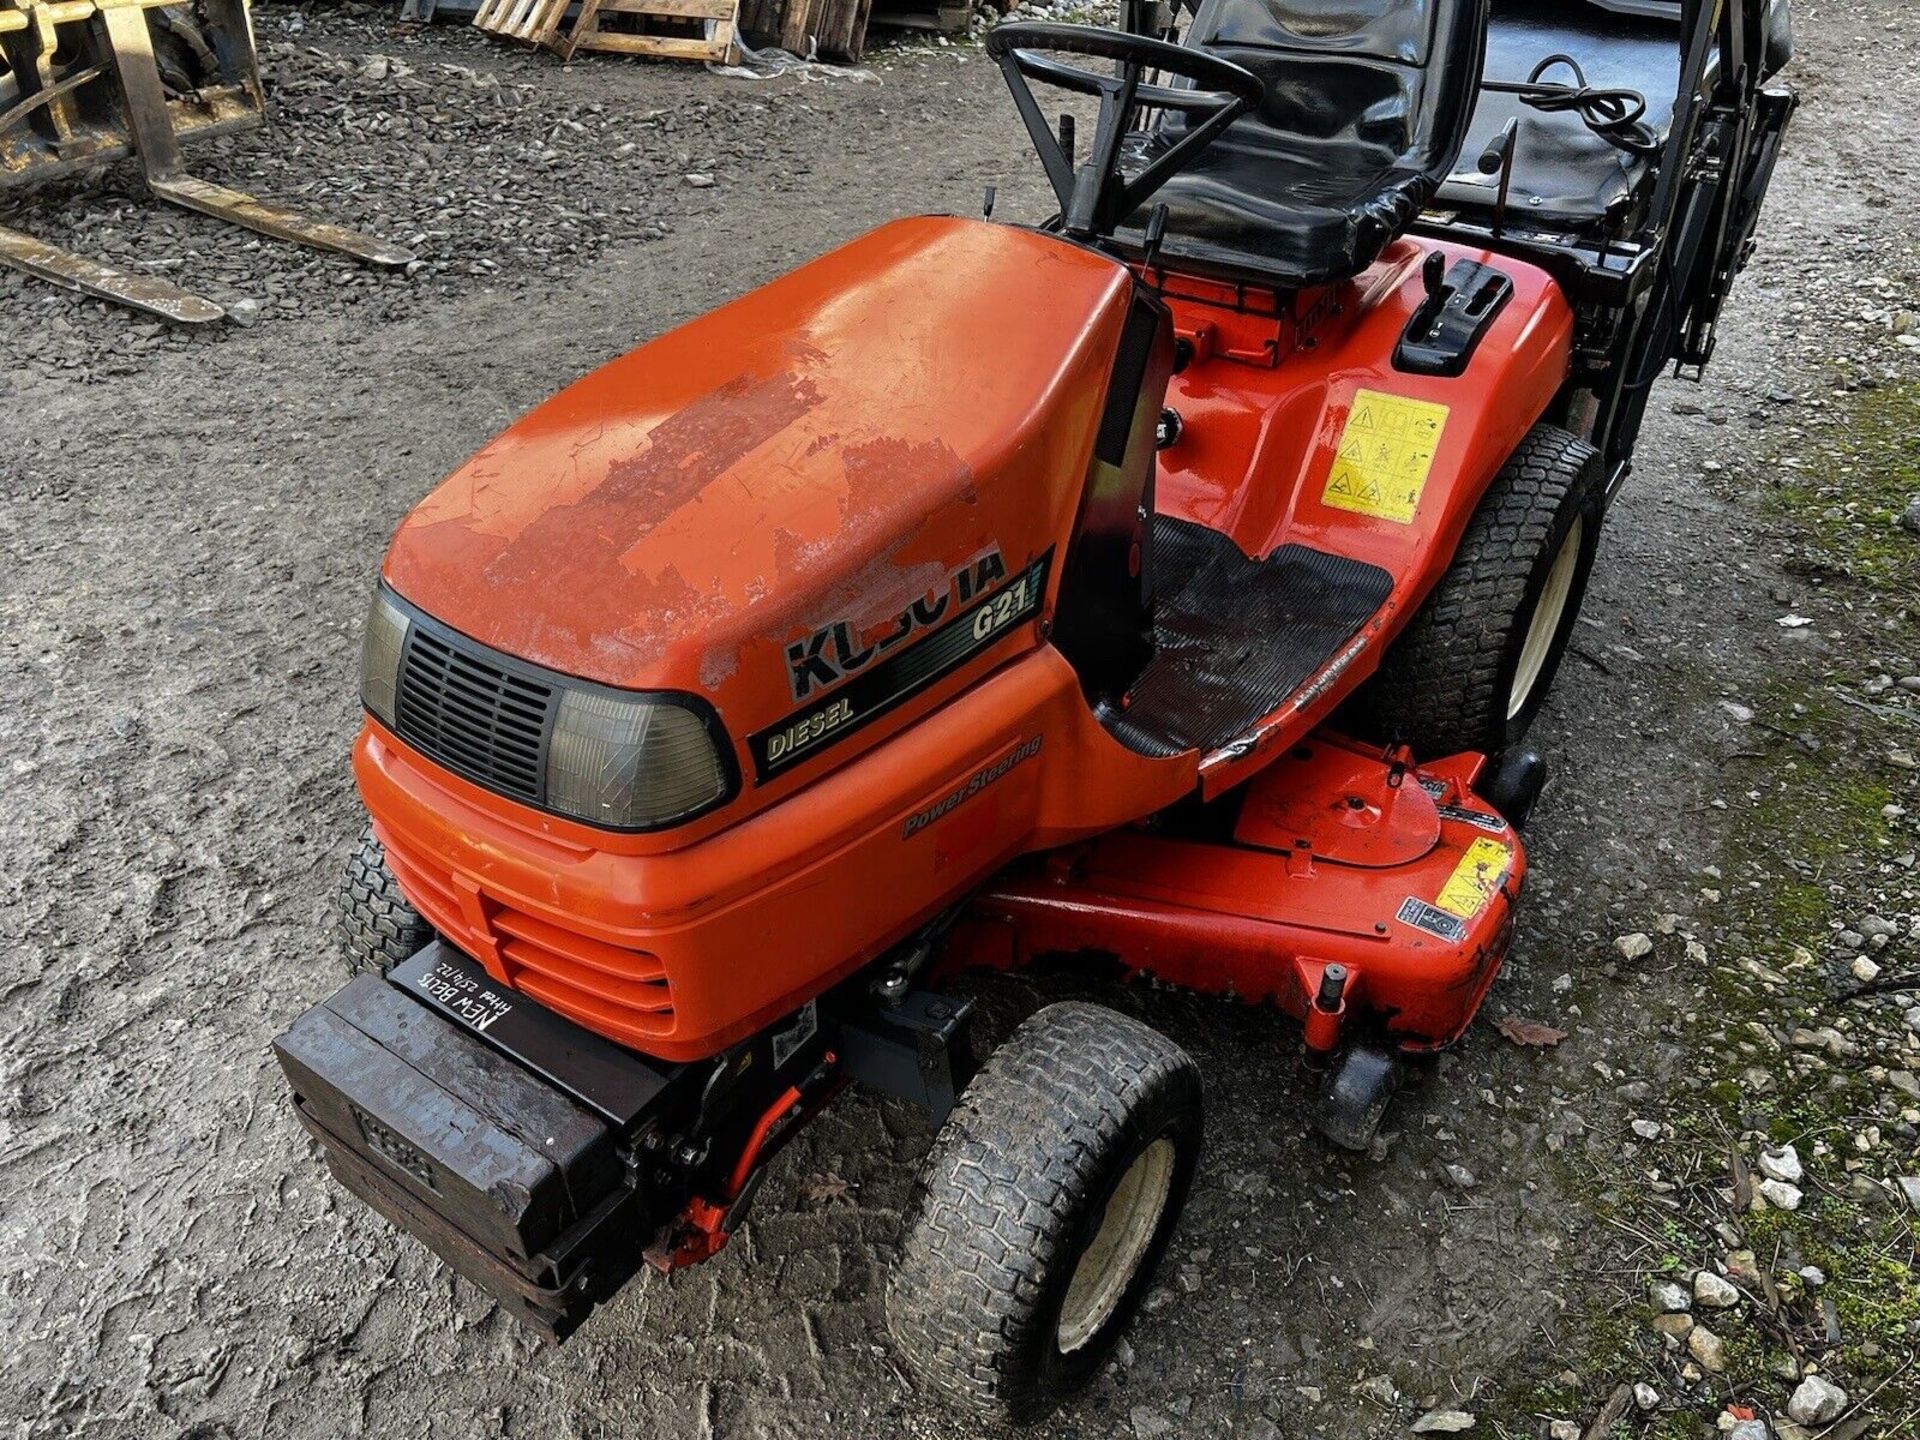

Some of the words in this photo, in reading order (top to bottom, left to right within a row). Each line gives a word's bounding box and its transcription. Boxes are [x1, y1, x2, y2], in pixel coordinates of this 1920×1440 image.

[767, 698, 855, 762] DIESEL
[972, 577, 1029, 642] G21
[902, 786, 969, 841] Power
[966, 733, 1043, 796] Steering
[417, 973, 460, 1003] BELTS
[436, 962, 479, 993] 25/4/22
[452, 997, 498, 1031] NEW
